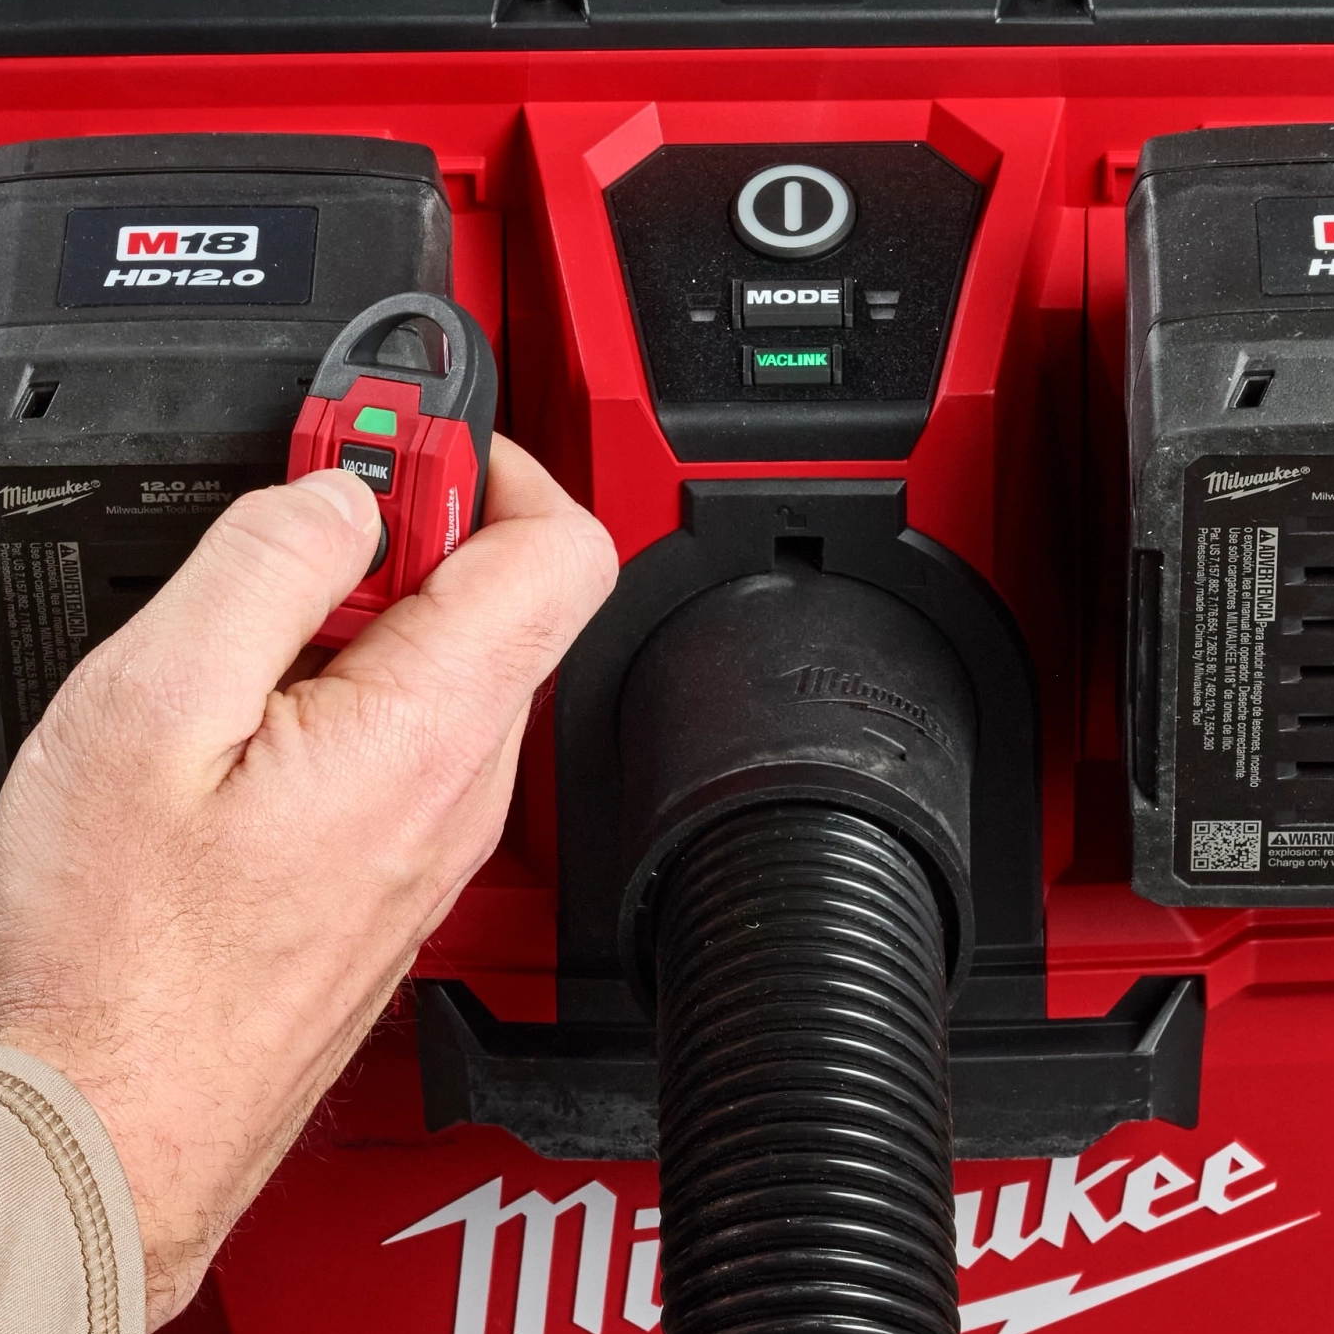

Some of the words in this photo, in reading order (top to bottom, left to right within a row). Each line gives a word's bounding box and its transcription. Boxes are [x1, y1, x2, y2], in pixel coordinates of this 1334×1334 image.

[126, 232, 250, 255] M18
[103, 268, 266, 287] HD12.0
[747, 289, 840, 305] MODE
[756, 353, 829, 367] VACLINK
[342, 458, 389, 480] VACLINK
[140, 481, 185, 491] 12.0
[192, 481, 220, 490] AH
[1229, 527, 1240, 543] Use
[1194, 527, 1208, 586] Professionally
[1209, 544, 1220, 555] US
[1225, 564, 1238, 609] cargadores
[1242, 578, 1254, 589] lea
[1256, 544, 1275, 619] ADVERTENCIA
[61, 559, 86, 635] ADVERTENCIA
[1196, 588, 1206, 611] made
[1241, 602, 1252, 630] manual
[1195, 623, 1204, 648] China
[1225, 612, 1238, 663] MILWAUKEE
[1240, 633, 1251, 644] del
[1255, 622, 1267, 640] Para
[1193, 650, 1205, 660] by
[1254, 643, 1266, 669] reducir
[1253, 671, 1265, 679] el
[1193, 663, 1204, 707] Milwaukee
[1224, 689, 1234, 699] de
[1250, 681, 1264, 704] riesgo
[1238, 686, 1250, 721] Deseche
[1252, 707, 1264, 717] de
[1193, 708, 1203, 725] Tool
[1222, 725, 1233, 734] de
[1250, 755, 1262, 788] incendio
[1268, 858, 1305, 869] Charge
[1307, 858, 1328, 869] only
